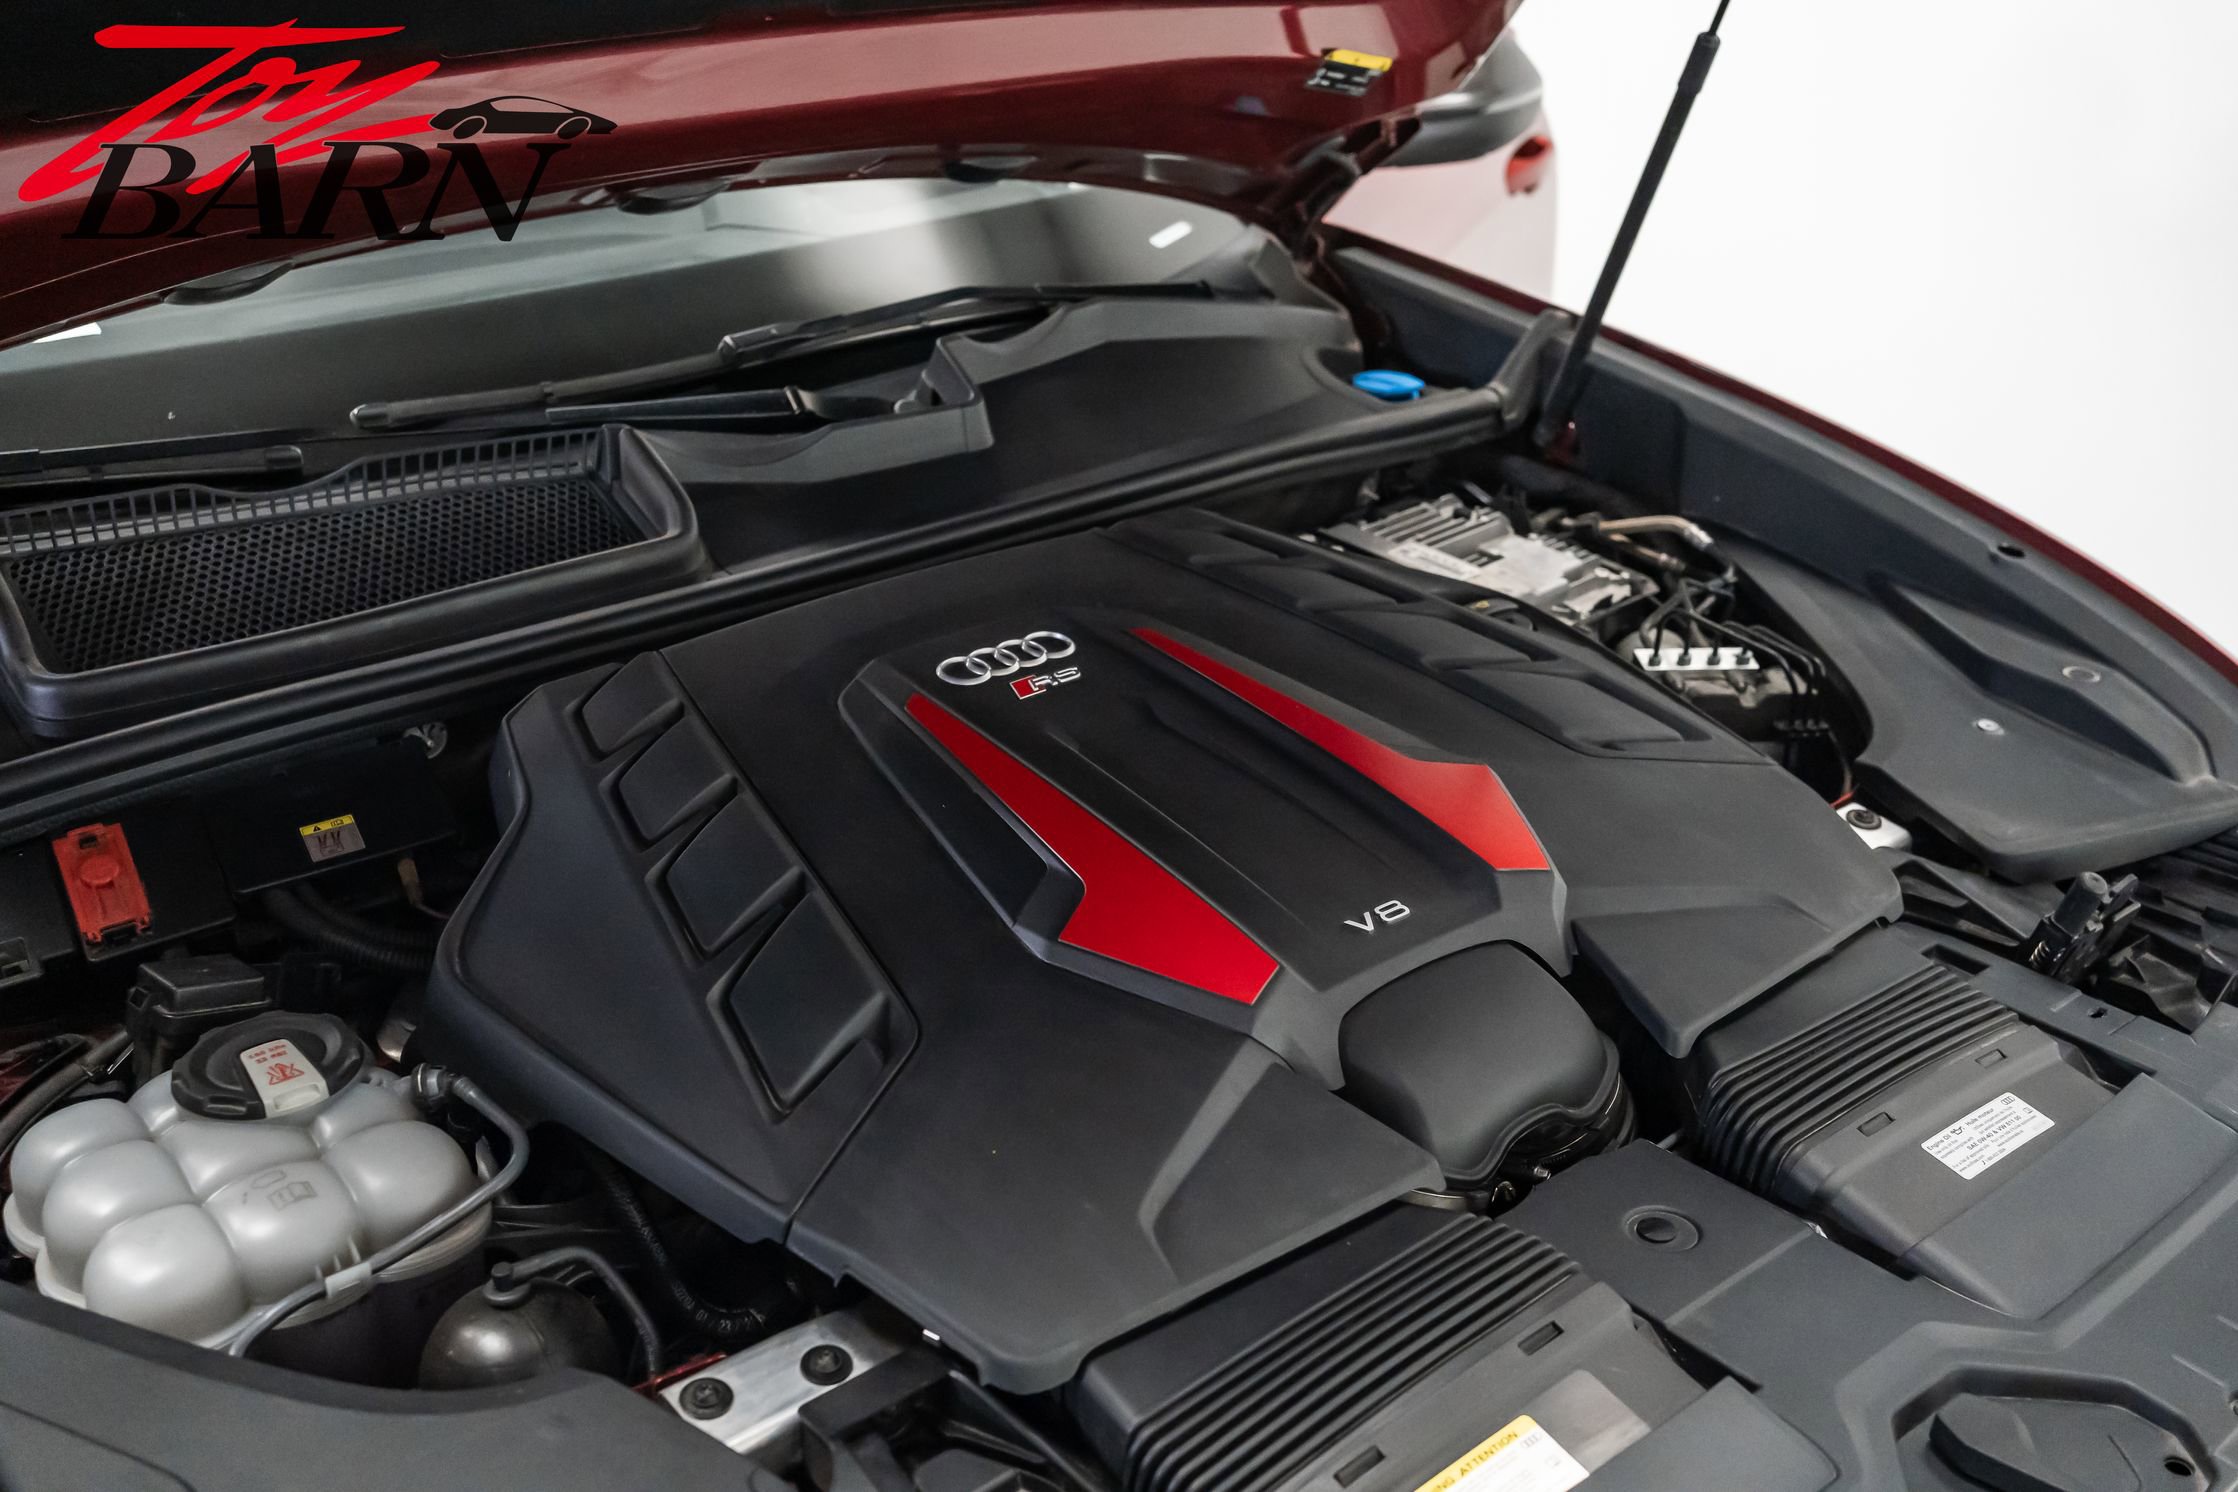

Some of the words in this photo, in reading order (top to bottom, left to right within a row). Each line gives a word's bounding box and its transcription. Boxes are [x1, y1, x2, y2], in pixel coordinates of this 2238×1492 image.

[1343, 899, 1411, 932] V8
[1926, 1139, 1945, 1151] Engine
[1966, 1141, 1979, 1151] SAE
[1997, 1122, 2007, 1132] VW
[1460, 1433, 1518, 1476] ATTENTION
